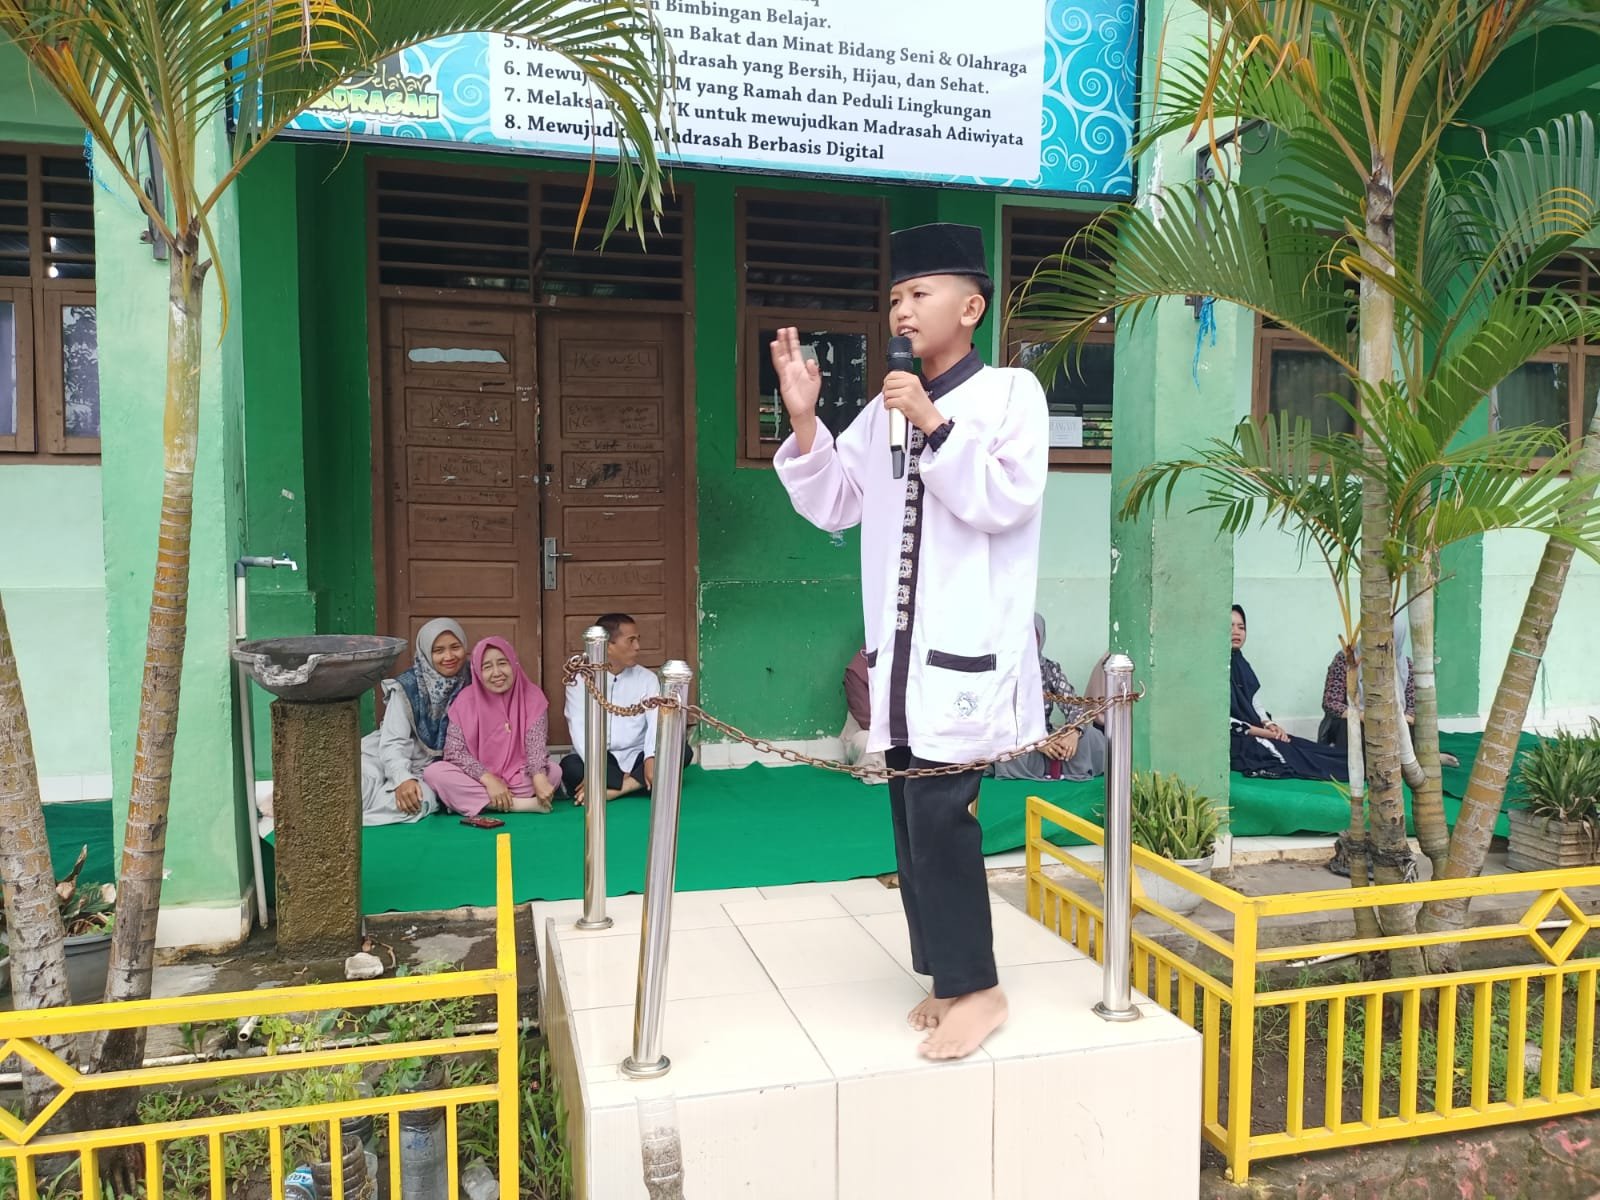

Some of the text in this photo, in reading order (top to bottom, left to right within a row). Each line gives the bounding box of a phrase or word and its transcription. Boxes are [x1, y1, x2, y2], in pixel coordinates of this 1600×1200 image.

[666, 0, 762, 24] Bimbingan
[766, 8, 831, 31] Belajar.
[689, 25, 742, 45] Bakat
[745, 31, 778, 49] dan
[782, 35, 834, 54] Minat
[838, 41, 896, 65] Bidang
[899, 47, 934, 64] Seni
[938, 51, 952, 66] &
[956, 53, 1028, 78] Olahraga
[340, 61, 430, 100] elajar
[503, 60, 992, 121] 6. Mewujka DM yang Ramah dan Peduli Lingkungan
[742, 60, 784, 80] yang
[788, 61, 847, 84] Bersih,
[852, 67, 902, 89] Hijau,
[906, 72, 936, 89] dan
[940, 76, 989, 94] Sehat.
[309, 87, 439, 119] ADRASAH
[504, 86, 521, 103] 7.
[527, 88, 649, 114] Melaksana
[694, 106, 747, 123] untuk
[751, 111, 859, 133] mewujudkan
[863, 118, 942, 139] Madrasah
[945, 125, 1024, 149] Adiwiyata
[504, 113, 522, 130] 8.
[527, 114, 632, 141] Mewujudk
[747, 134, 822, 155] Berbasis
[826, 140, 885, 163] Digital
